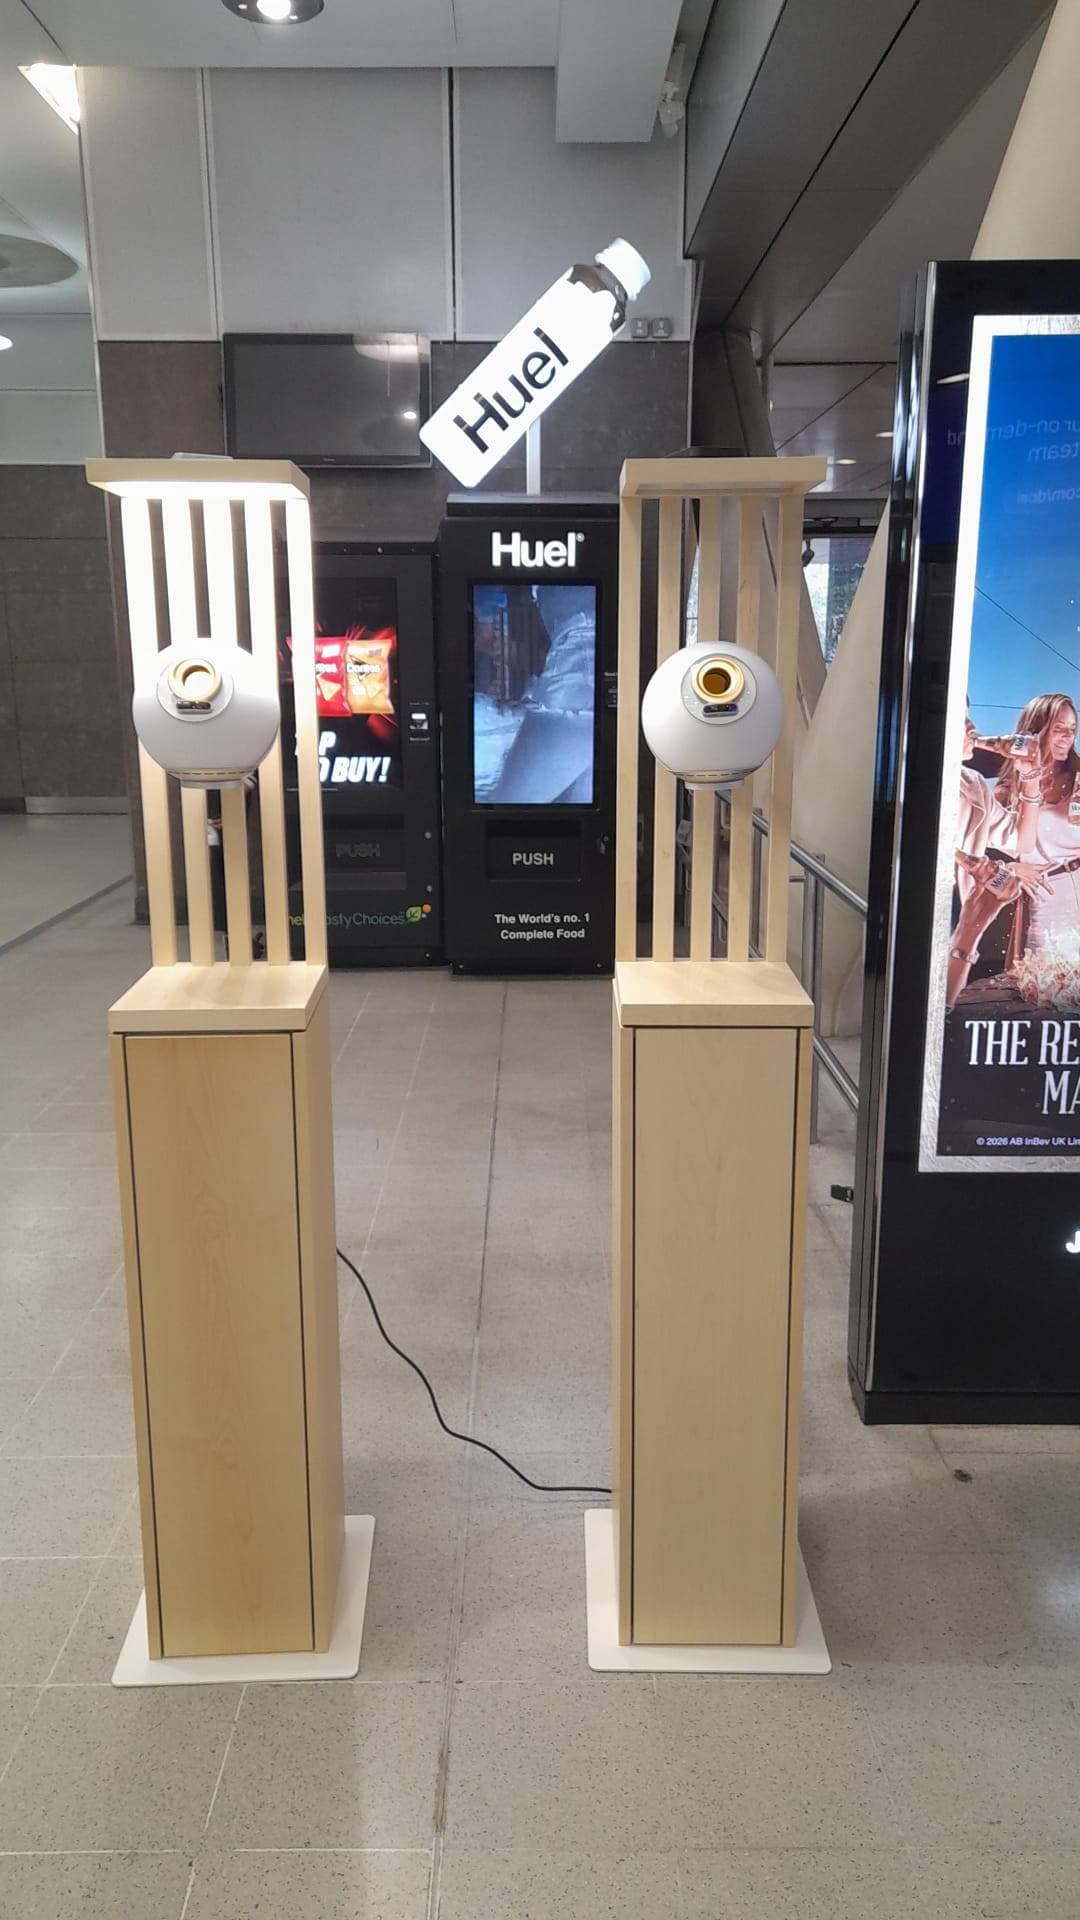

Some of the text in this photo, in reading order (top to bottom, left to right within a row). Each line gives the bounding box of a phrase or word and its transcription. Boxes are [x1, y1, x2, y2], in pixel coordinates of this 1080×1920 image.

[453, 327, 569, 454] Huel
[330, 756, 392, 783] BUY!
[512, 852, 554, 866] PUSH
[325, 912, 404, 929] astyChoices
[494, 912, 590, 924] The World's no. 1
[500, 928, 585, 941] Complete Food
[964, 1020, 1031, 1065] THE
[1009, 1137, 1023, 1146] AB
[1024, 1137, 1050, 1146] InBev
[1051, 1137, 1066, 1146] UK
